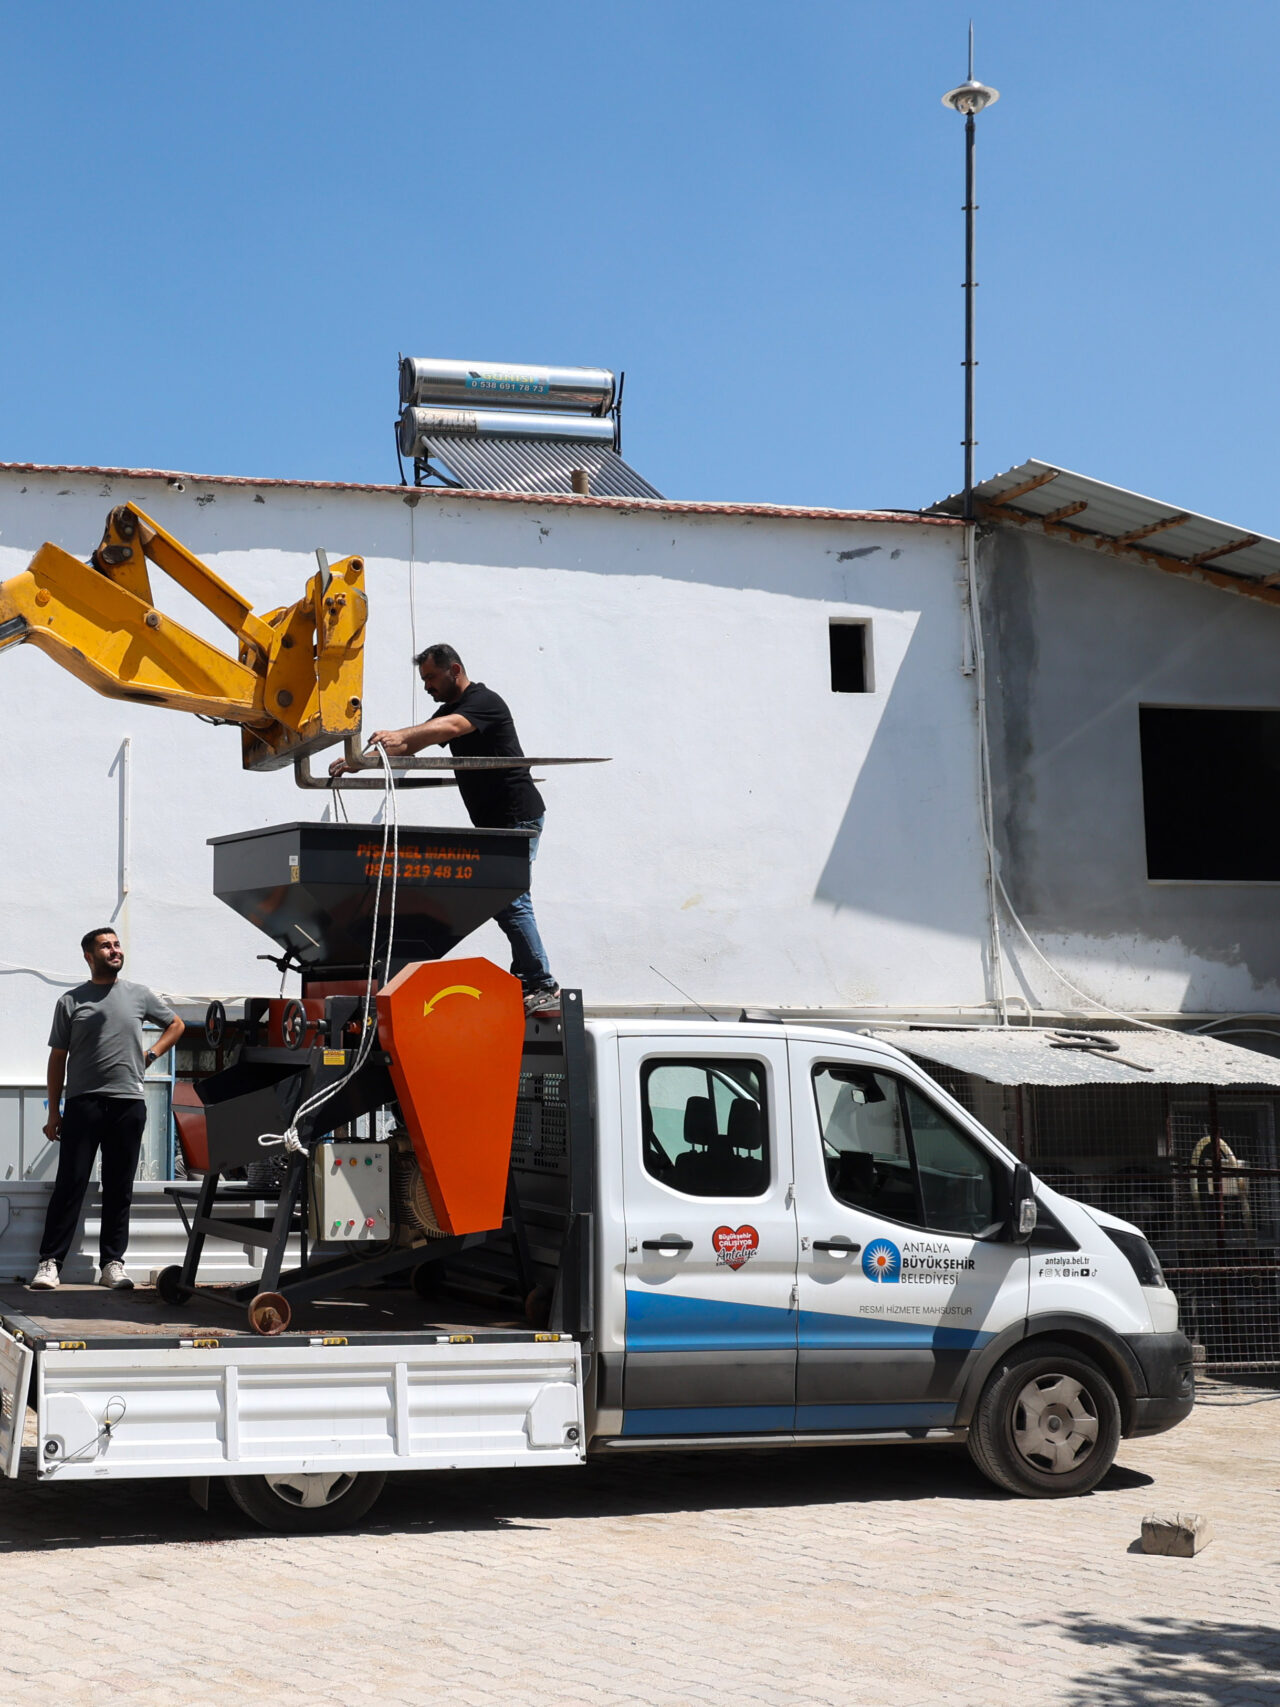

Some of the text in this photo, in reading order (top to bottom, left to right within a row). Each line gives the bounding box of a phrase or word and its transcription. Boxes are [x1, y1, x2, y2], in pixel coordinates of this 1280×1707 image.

[480, 381, 497, 389] 538
[500, 383, 516, 391] 691
[519, 384, 530, 392] 78
[365, 863, 473, 879] 055 219 48 10
[716, 1246, 758, 1262] Antalya
[902, 1242, 951, 1254] ANTALYA
[902, 1255, 976, 1272] BÜYÜKŞEHİR
[1045, 1256, 1090, 1266] antalya.bel.tr
[901, 1272, 960, 1286] BELEDİYESİ
[860, 1304, 972, 1316] RESMİ HİZMETE MAHSUSTUR
